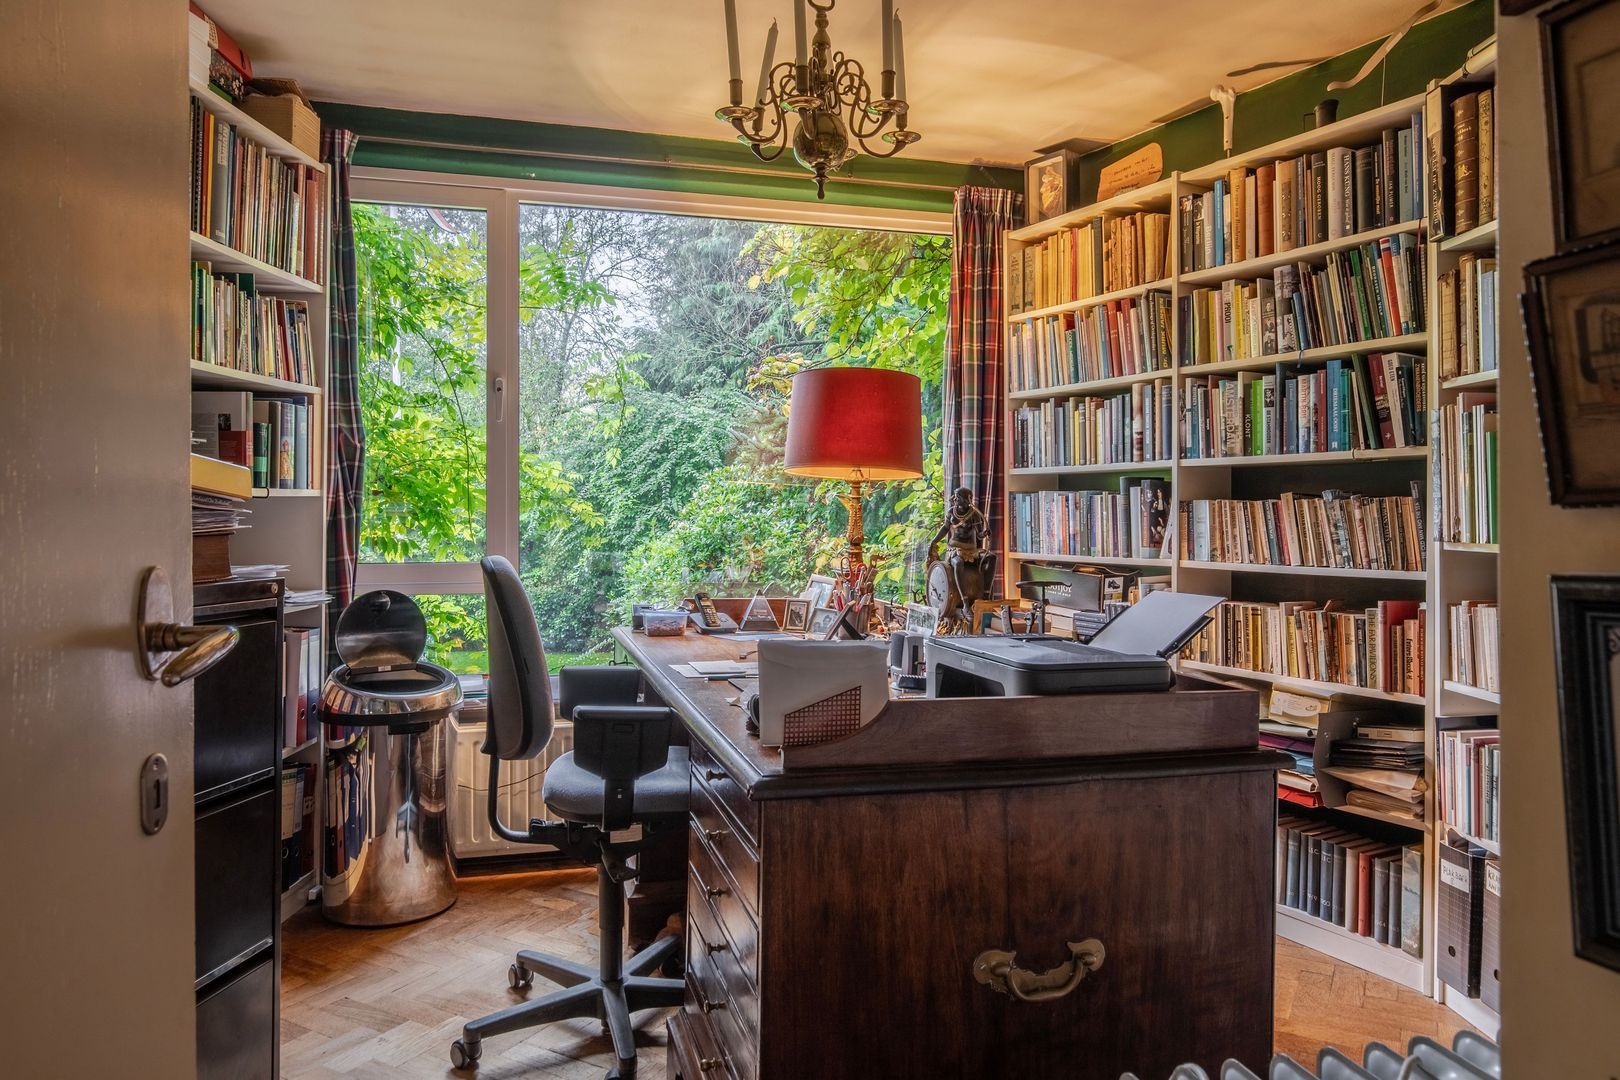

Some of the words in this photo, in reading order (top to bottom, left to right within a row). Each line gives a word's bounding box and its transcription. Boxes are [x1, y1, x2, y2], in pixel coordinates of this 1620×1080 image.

[1343, 154, 1351, 175] HANS
[1343, 175, 1352, 198] KÜNG
[1224, 302, 1232, 324] PROOI
[1225, 382, 1235, 448] AMSTERDAM
[1367, 614, 1376, 629] THE
[1368, 629, 1377, 643] FAR
[1368, 643, 1378, 682] PAVILIONS
